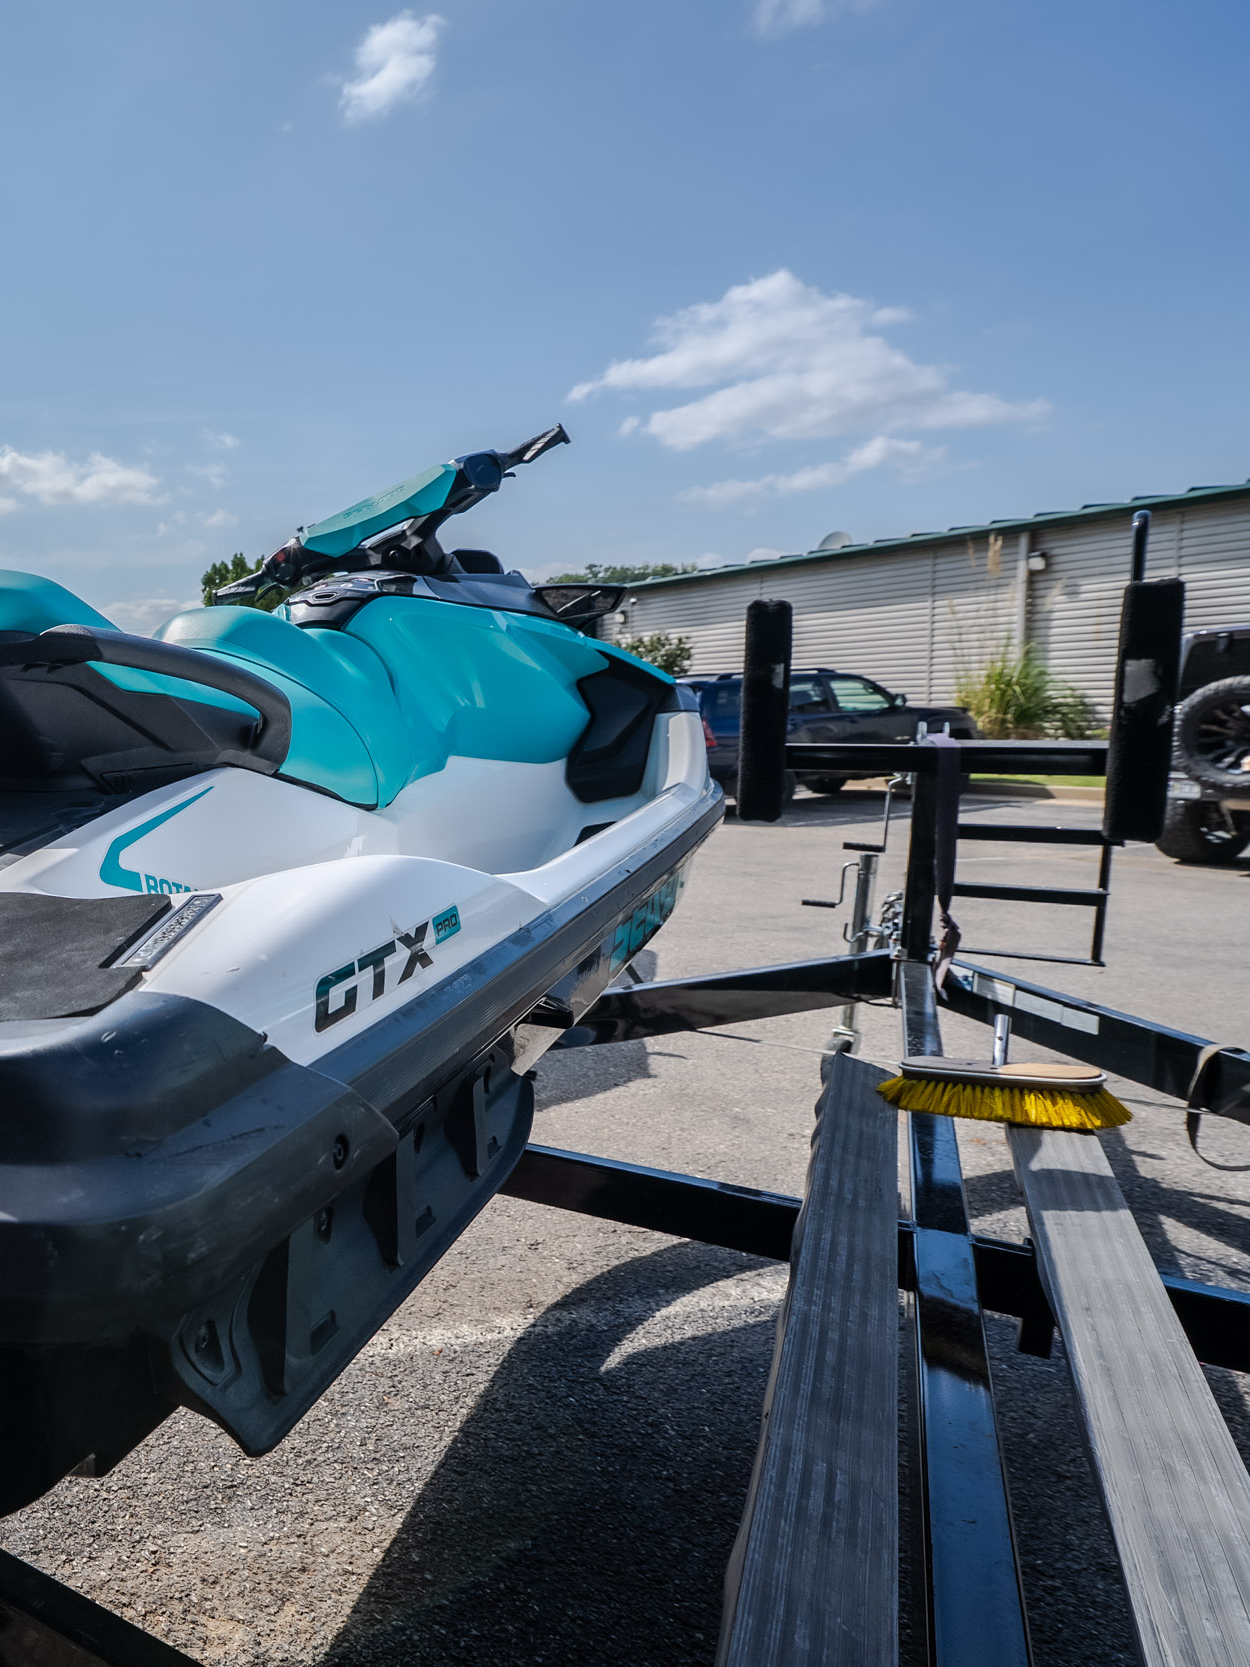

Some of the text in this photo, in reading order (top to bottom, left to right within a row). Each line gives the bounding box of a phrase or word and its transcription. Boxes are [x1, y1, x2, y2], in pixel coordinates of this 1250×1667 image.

[144, 873, 199, 895] ROT
[315, 913, 458, 1033] GTX PRO
